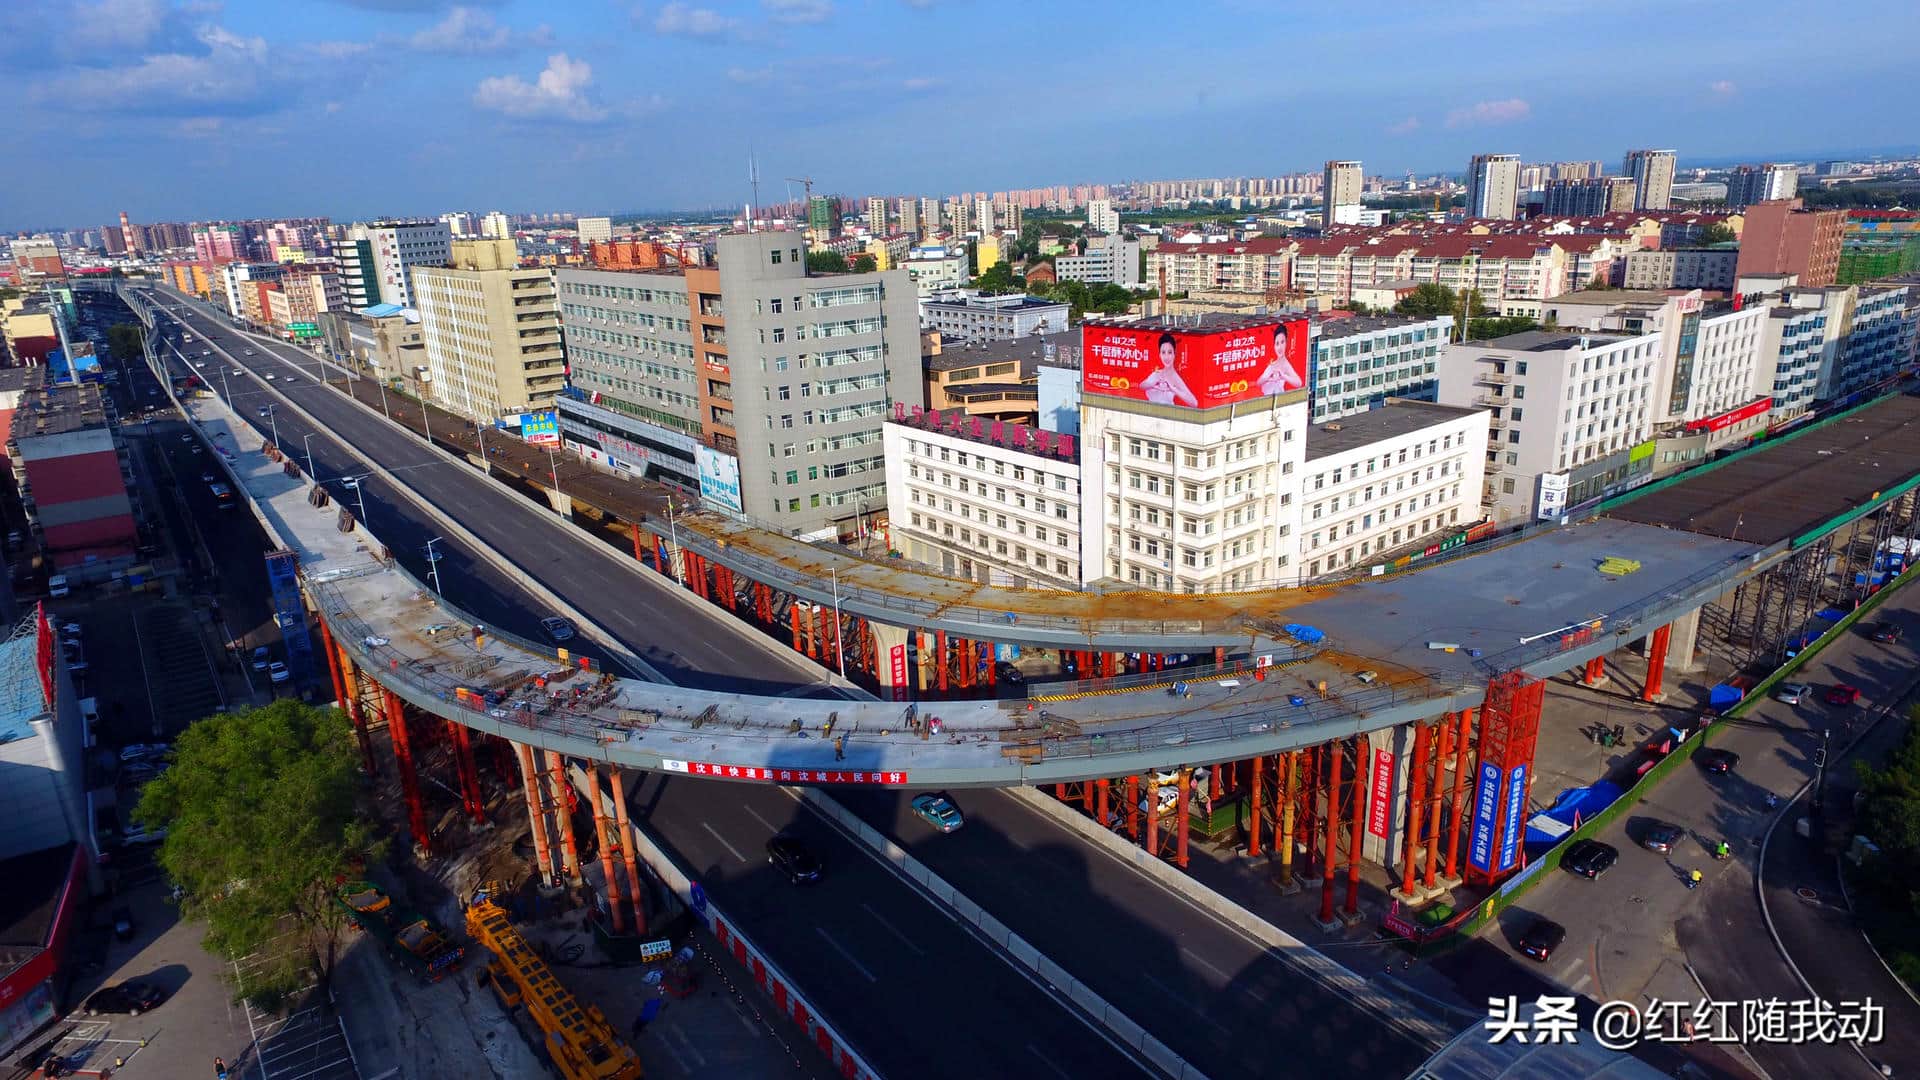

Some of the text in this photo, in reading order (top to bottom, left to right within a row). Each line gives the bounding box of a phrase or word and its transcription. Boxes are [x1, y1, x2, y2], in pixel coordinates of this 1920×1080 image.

[696, 763, 901, 783] 沈阳快速路向沈城人民问好
